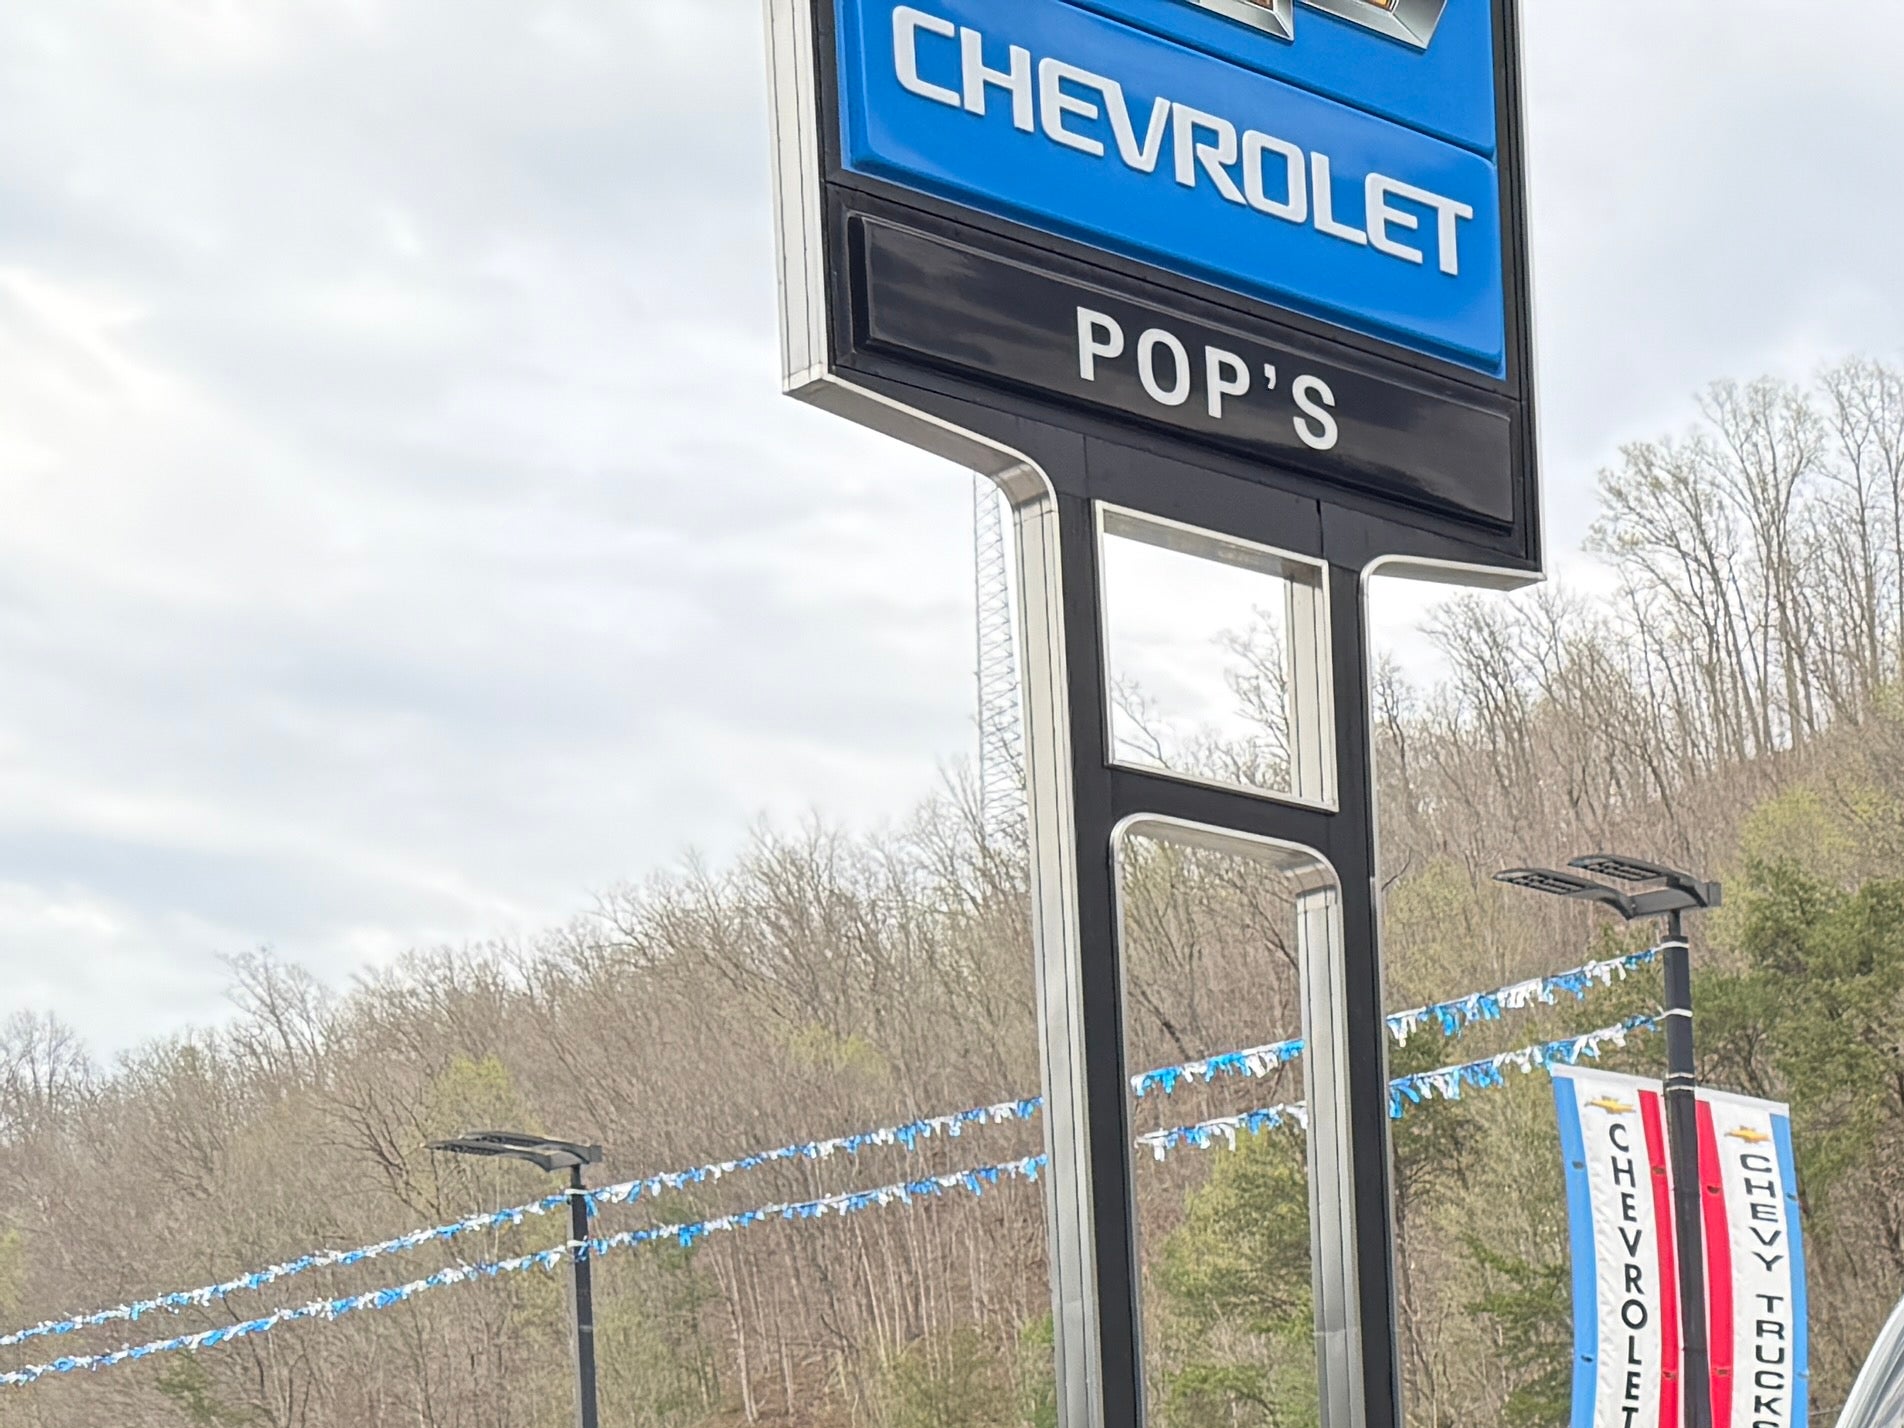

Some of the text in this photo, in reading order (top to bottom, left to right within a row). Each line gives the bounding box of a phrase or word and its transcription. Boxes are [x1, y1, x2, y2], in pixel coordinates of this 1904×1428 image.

[892, 5, 1473, 276] CHEVROLET
[1075, 305, 1340, 452] POP'S
[1739, 1153, 1782, 1273] CHEVY
